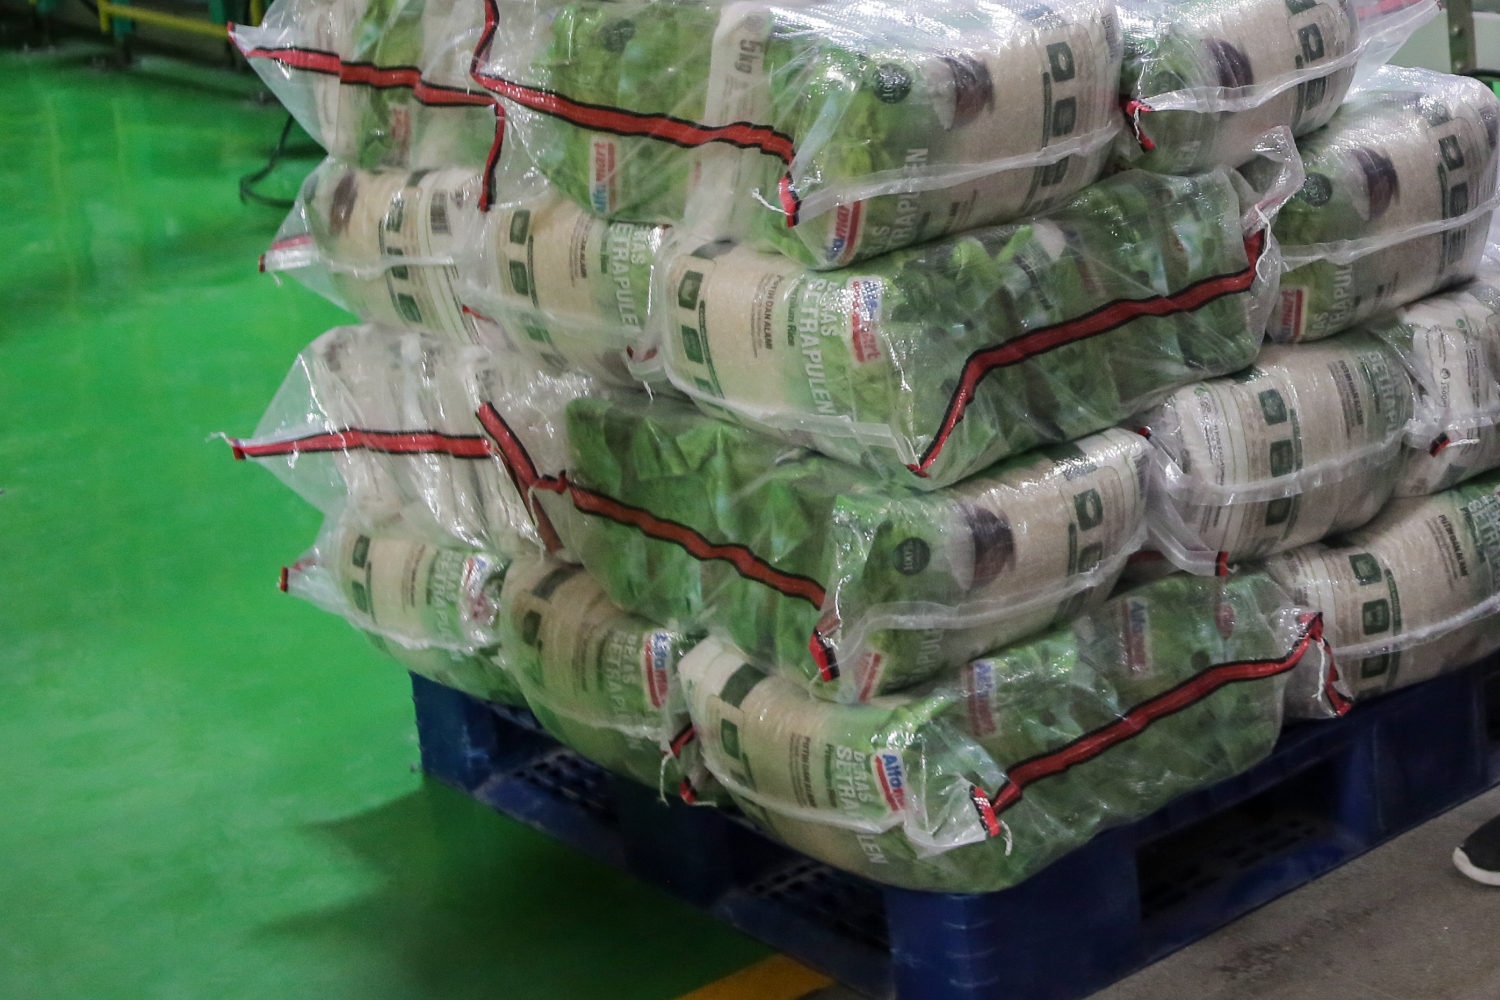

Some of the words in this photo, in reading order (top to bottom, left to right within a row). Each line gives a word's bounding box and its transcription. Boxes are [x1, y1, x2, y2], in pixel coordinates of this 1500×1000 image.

[734, 39, 764, 74] 5kg
[609, 222, 641, 328] ETRAPULE
[799, 278, 836, 416] SETRAPULEN
[836, 745, 888, 864] SETRALEN
[882, 754, 906, 808] Alfam
